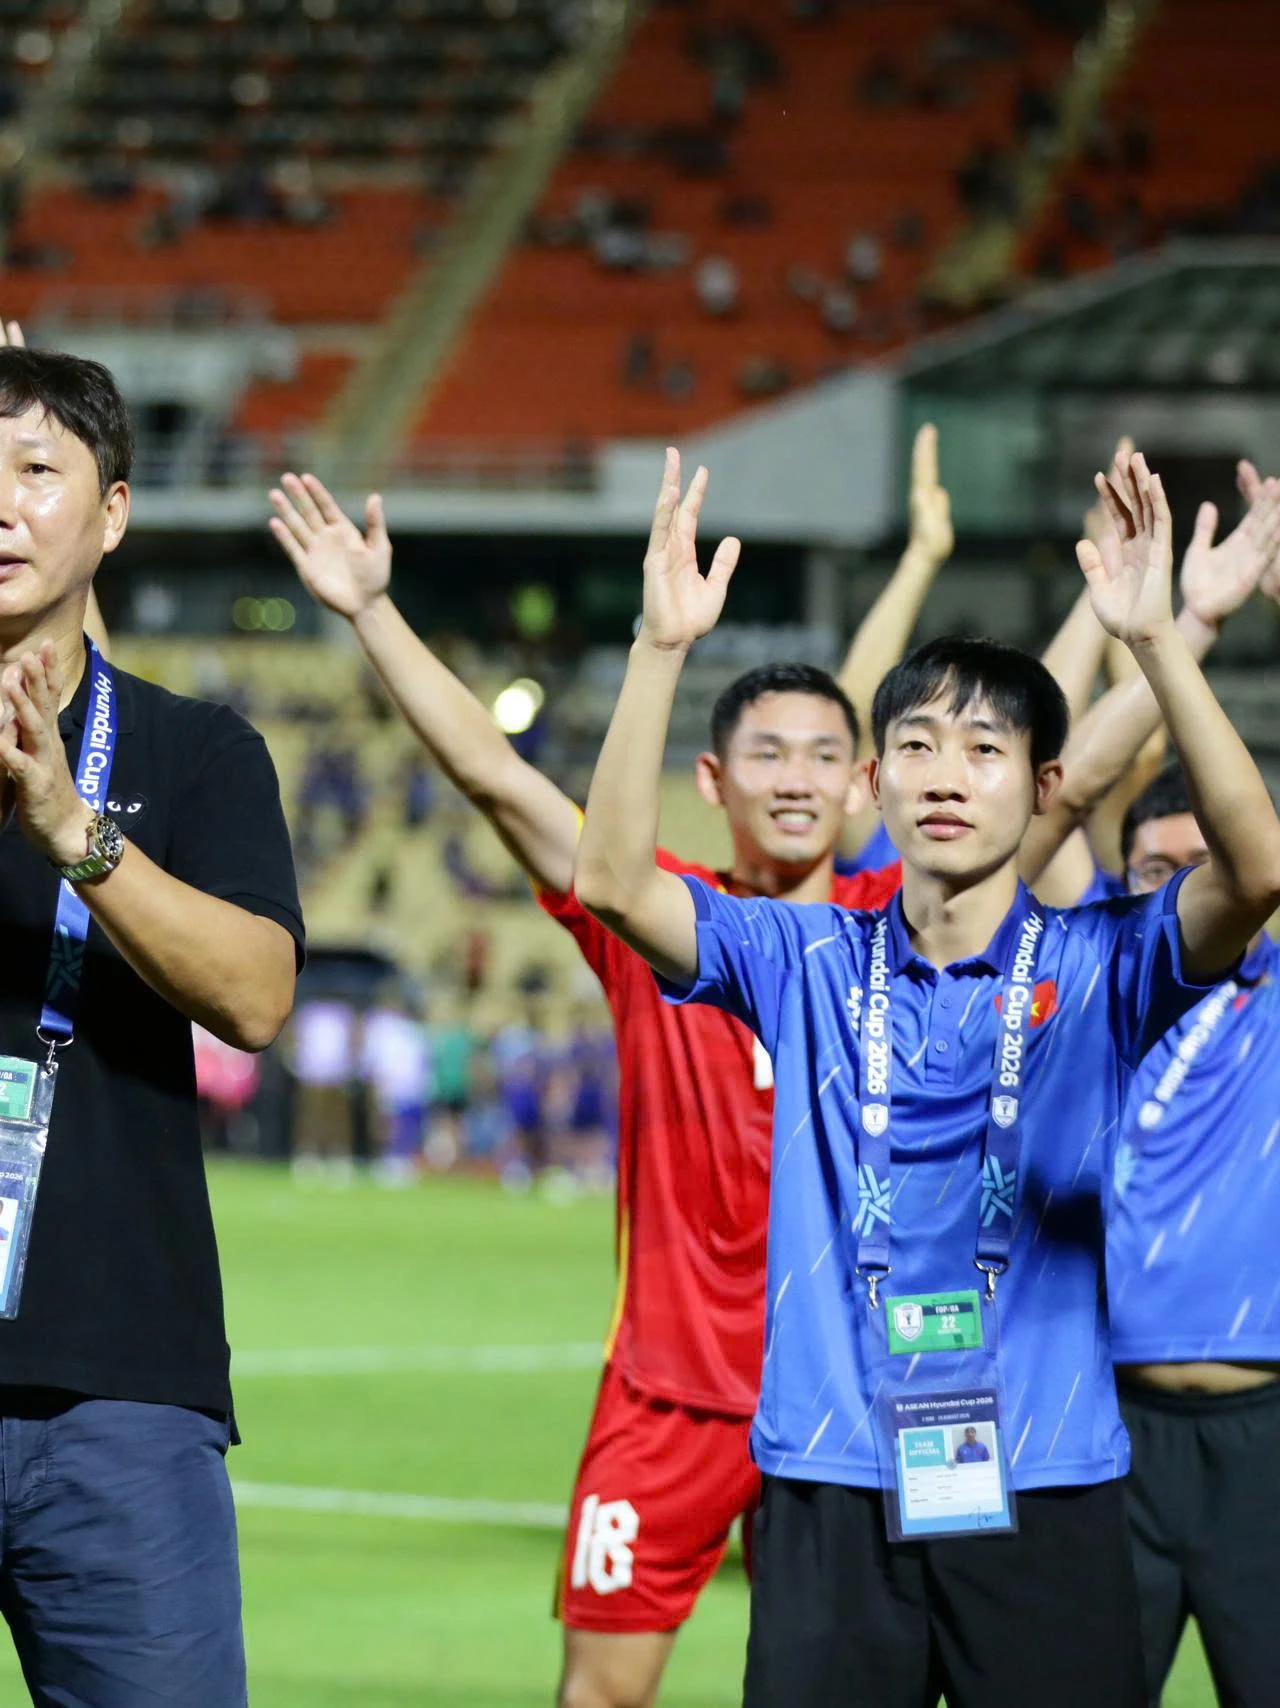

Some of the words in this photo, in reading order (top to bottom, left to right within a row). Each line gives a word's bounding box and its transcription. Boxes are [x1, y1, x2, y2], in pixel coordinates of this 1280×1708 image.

[90, 671, 112, 751] Hyundai
[78, 751, 108, 795] Cup
[870, 917, 891, 992] Hyundai
[1011, 911, 1044, 984] Hyundai
[865, 993, 890, 1038] Cup
[1003, 985, 1030, 1030] Cup
[867, 1040, 889, 1096] 2026
[999, 1032, 1024, 1088] 2026
[5, 1172, 24, 1181] 2026
[941, 1315, 957, 1329] 22
[571, 1493, 640, 1596] 18
